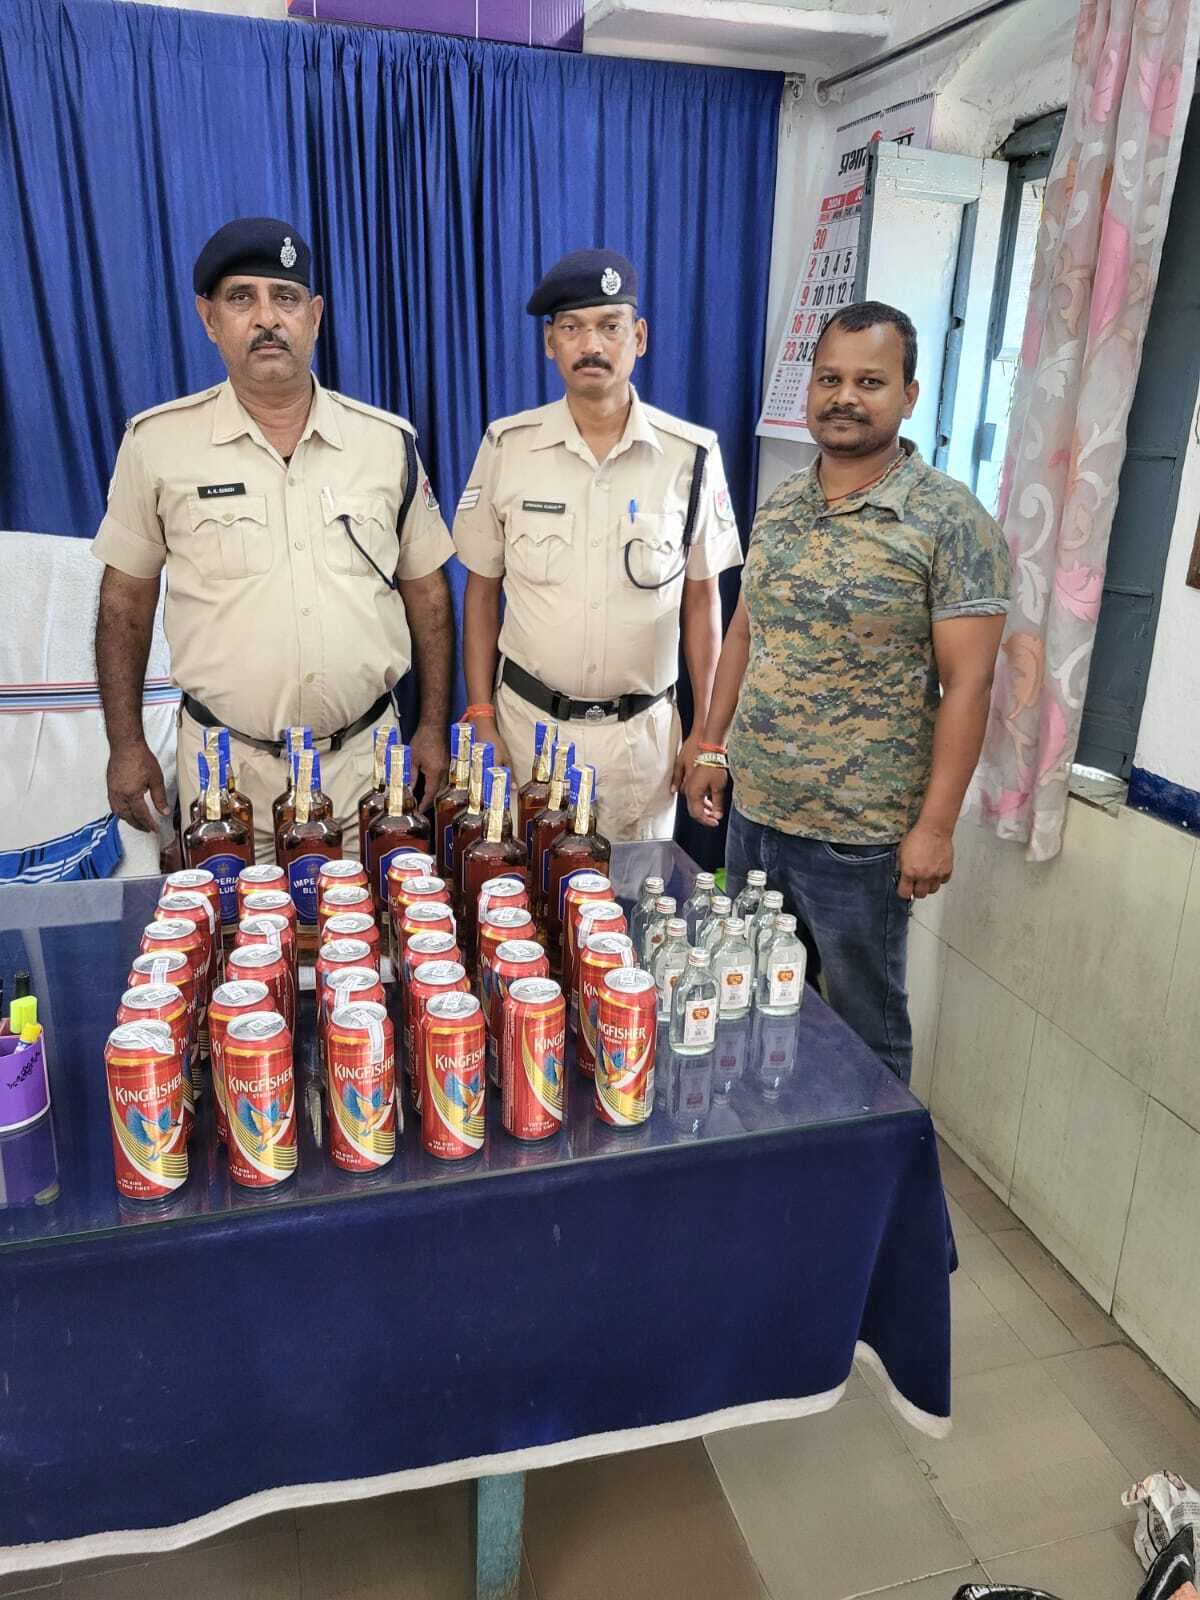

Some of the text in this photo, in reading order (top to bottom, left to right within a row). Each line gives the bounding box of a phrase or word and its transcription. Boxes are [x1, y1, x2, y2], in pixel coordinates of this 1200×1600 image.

[813, 228, 828, 251] 30
[807, 251, 853, 278] 2 3 4 5
[800, 285, 810, 306] 9
[812, 285, 825, 306] 10
[825, 283, 836, 305] 11
[836, 281, 848, 304] 12
[791, 313, 804, 334] 16
[804, 312, 817, 335] 17
[783, 341, 797, 361] 23
[796, 341, 810, 362] 24
